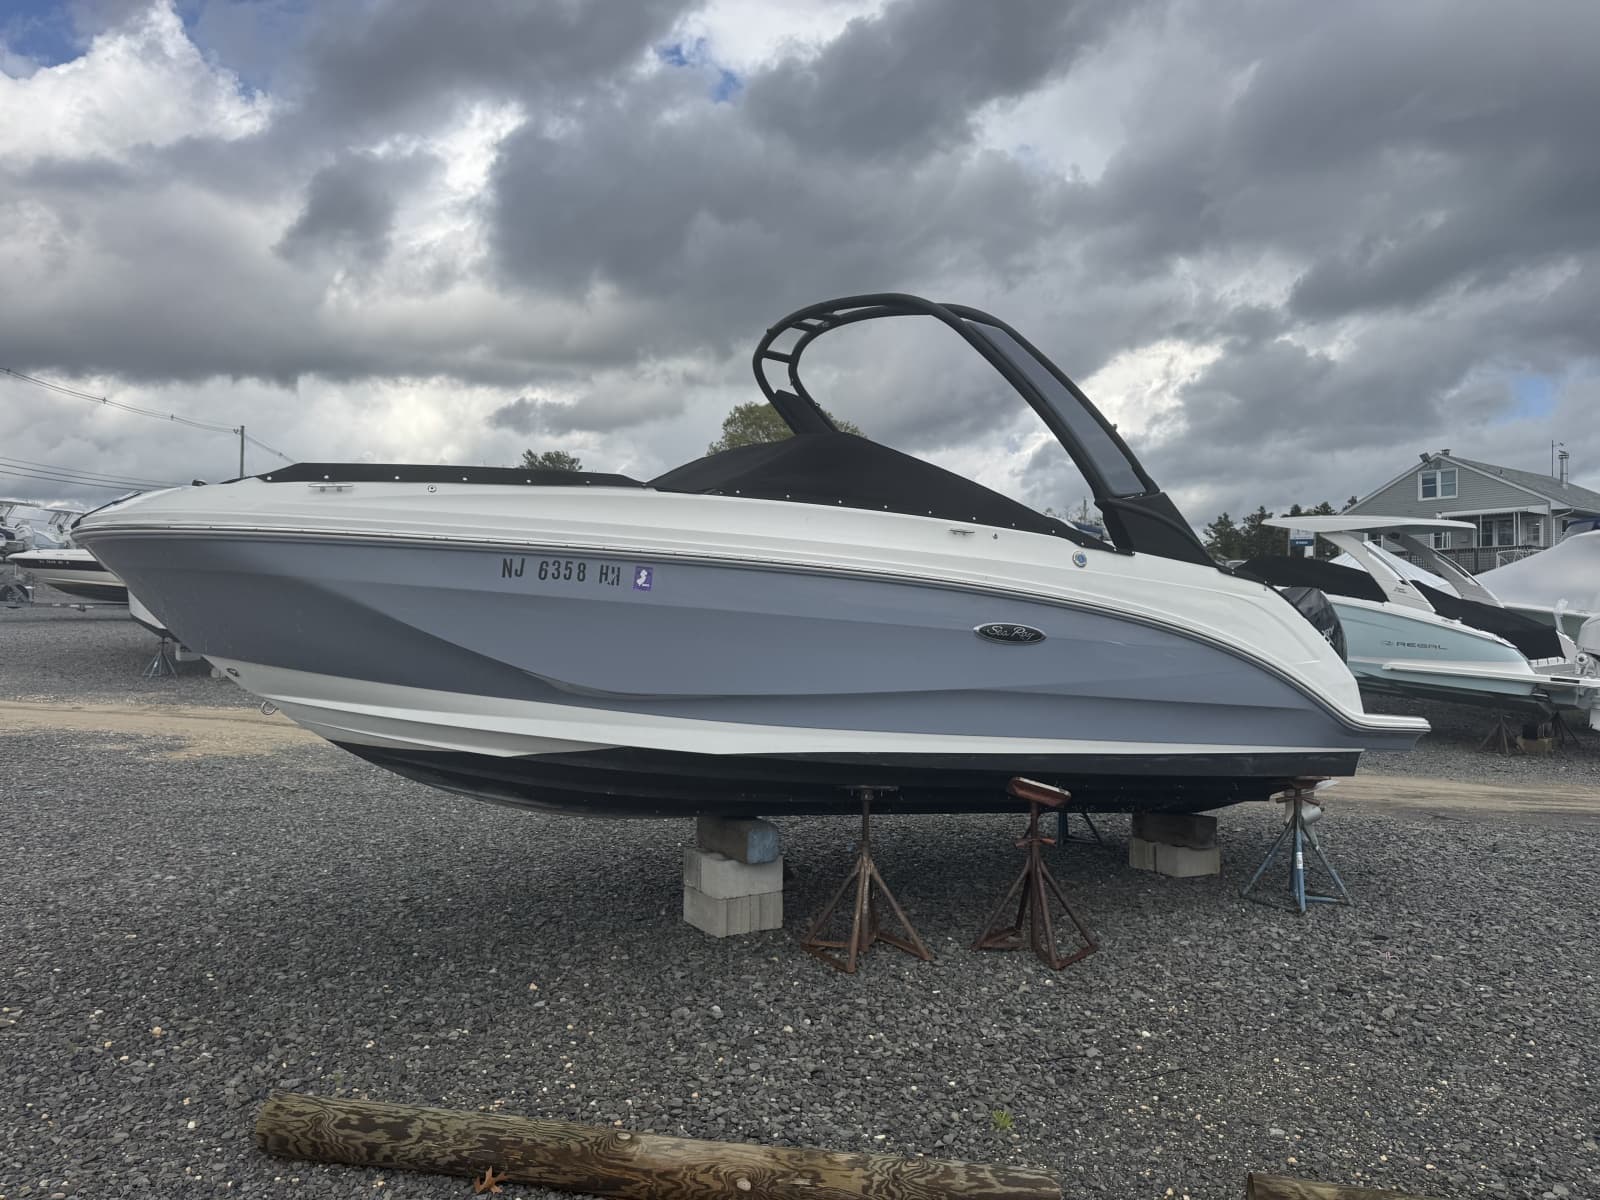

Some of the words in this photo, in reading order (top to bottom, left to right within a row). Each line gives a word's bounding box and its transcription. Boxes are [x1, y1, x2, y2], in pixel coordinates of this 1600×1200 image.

[501, 557, 526, 578] NJ
[538, 560, 587, 582] 6358
[987, 625, 1009, 637] Sea
[1010, 626, 1034, 641] Ray
[1396, 641, 1449, 651] REGAL
